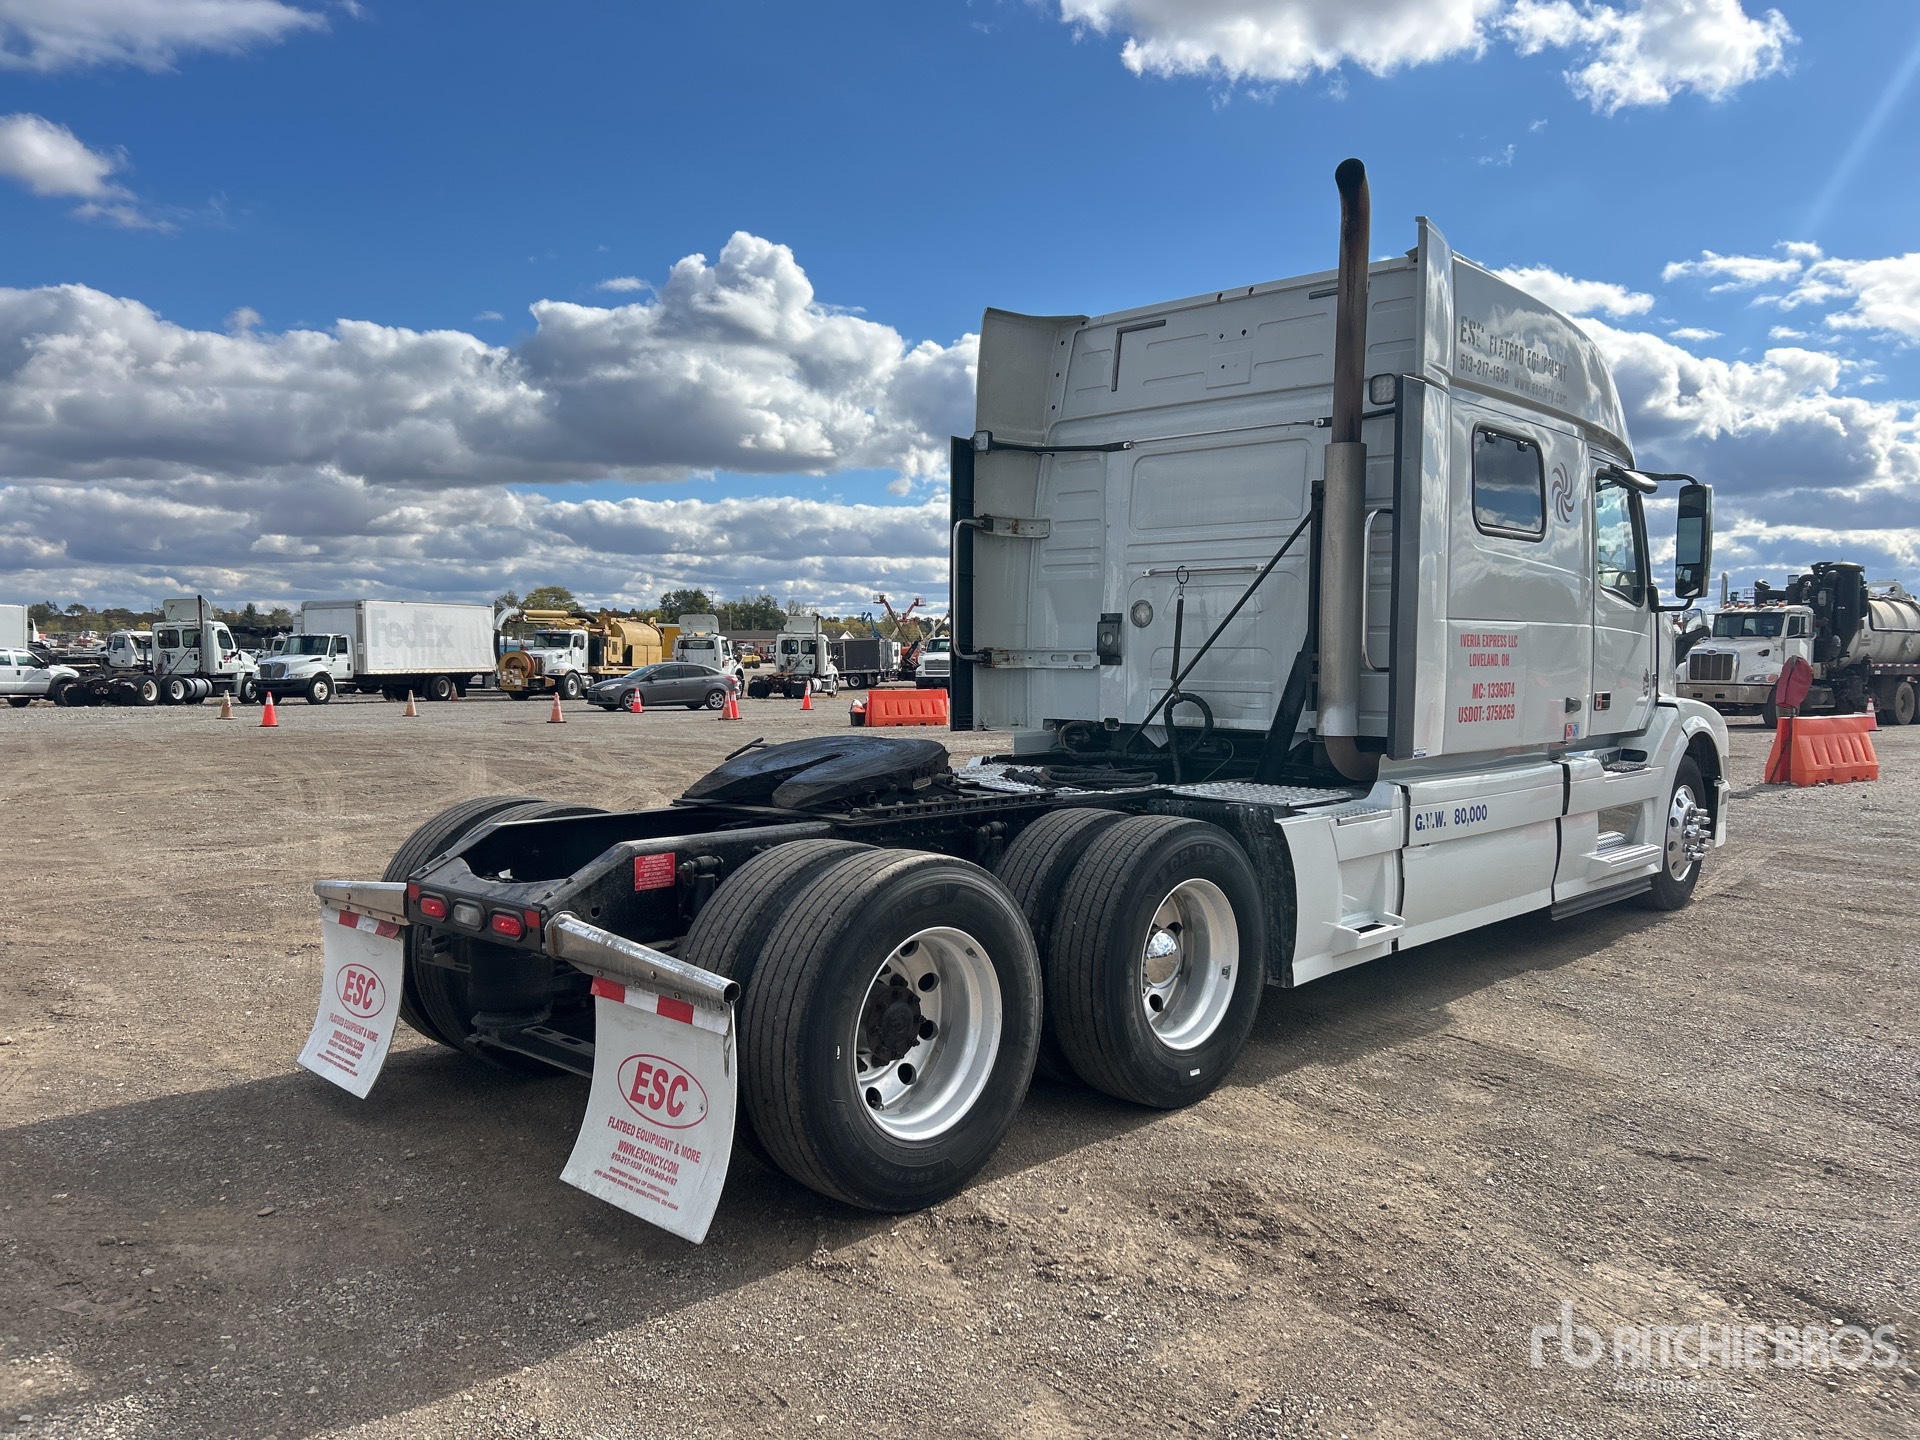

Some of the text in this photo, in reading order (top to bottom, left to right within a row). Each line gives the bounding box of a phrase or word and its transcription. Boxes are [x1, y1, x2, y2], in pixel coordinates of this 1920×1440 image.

[1460, 353, 1509, 385] 513-217-1539
[370, 609, 454, 649] FedEx
[1460, 634, 1518, 648] IVERIA EXPRESS LLC
[1469, 653, 1510, 668] LOVELAND, OH
[1472, 682, 1515, 700] MC: 1336874
[1458, 704, 1515, 723] USDOT: 3758269
[1454, 804, 1487, 827] 80,000
[342, 969, 376, 1010] ESC
[629, 1061, 688, 1117] ESC
[608, 1115, 701, 1163] FLATBED EQUIPMENT & MORE
[617, 1139, 679, 1175] WWW.ESCINCY.COM
